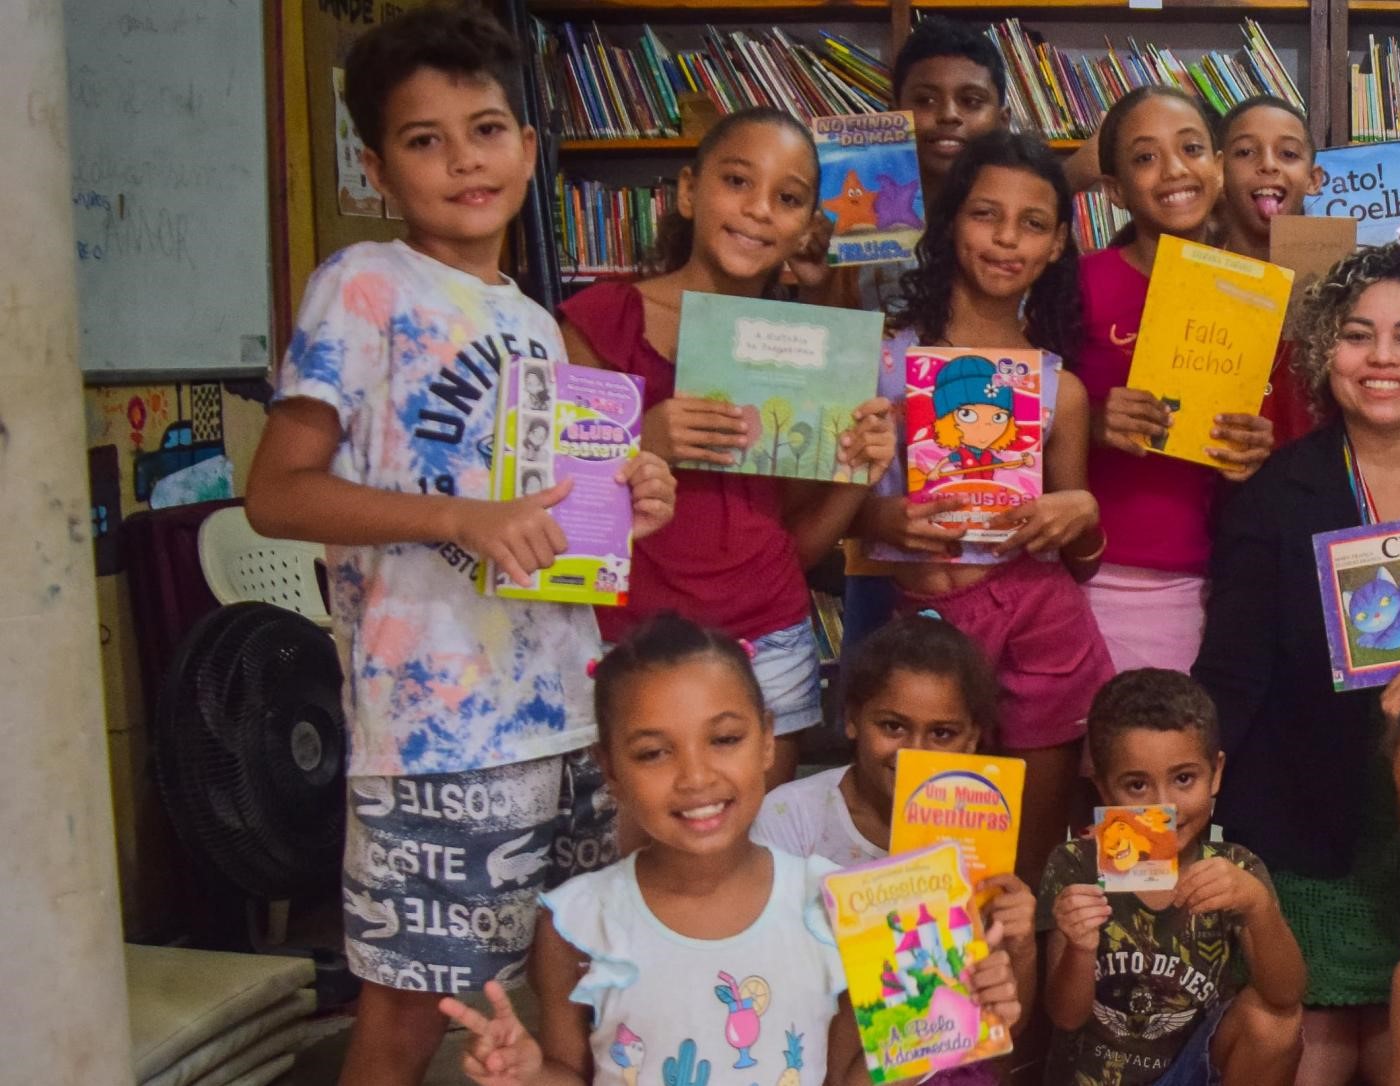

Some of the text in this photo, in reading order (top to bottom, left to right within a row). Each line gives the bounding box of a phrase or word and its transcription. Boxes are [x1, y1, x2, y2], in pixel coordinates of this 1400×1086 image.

[846, 113, 906, 131] FUNDO
[1183, 318, 1233, 350] Fala,
[1171, 346, 1244, 377] bicho!
[954, 786, 1002, 806] Mundo
[905, 802, 1010, 833] Aventuras
[1151, 952, 1181, 978] DE
